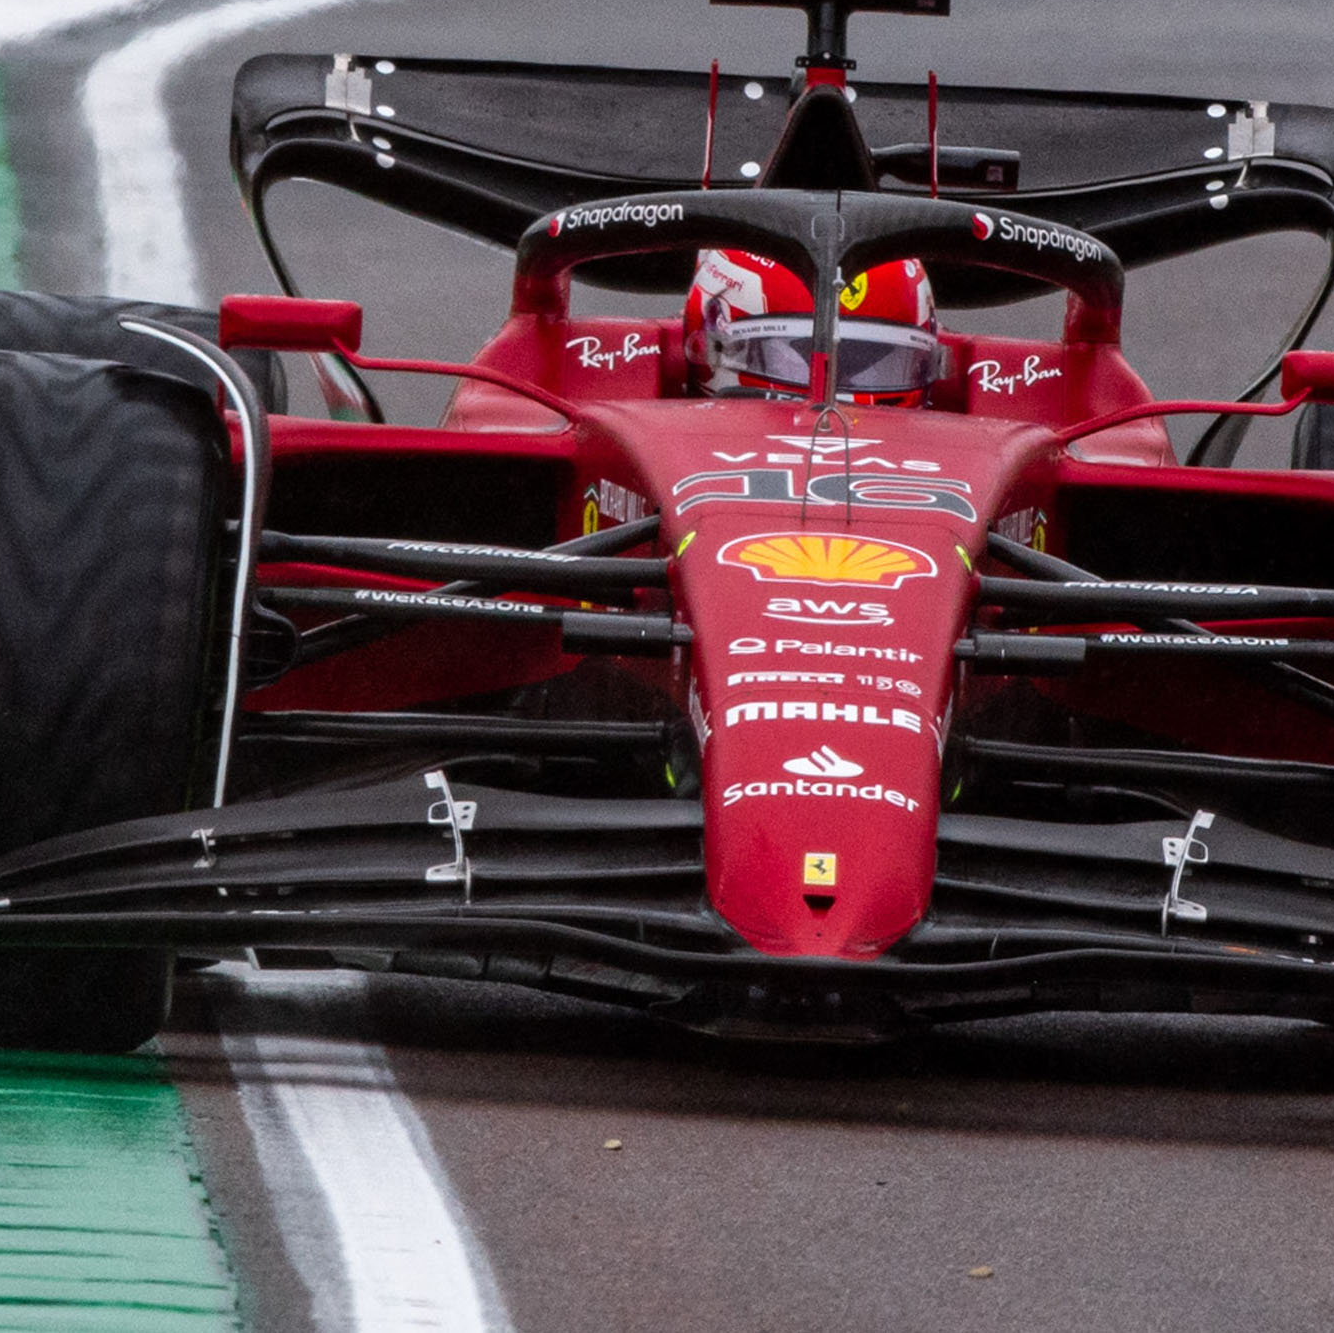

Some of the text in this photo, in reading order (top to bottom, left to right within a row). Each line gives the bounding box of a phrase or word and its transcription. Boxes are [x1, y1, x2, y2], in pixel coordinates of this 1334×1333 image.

[567, 201, 684, 230] Snapdragon
[999, 217, 1103, 262] Snapdragon
[566, 333, 660, 370] Ray-Ban
[967, 355, 1063, 394] Ray-Ban
[712, 451, 941, 471] VELAS
[672, 469, 977, 523] 16
[354, 589, 544, 614] #WeRaceAsOne
[767, 598, 889, 617] aws
[775, 639, 923, 663] Palantir
[726, 702, 921, 734] MAHLE
[723, 778, 920, 813] Santander
